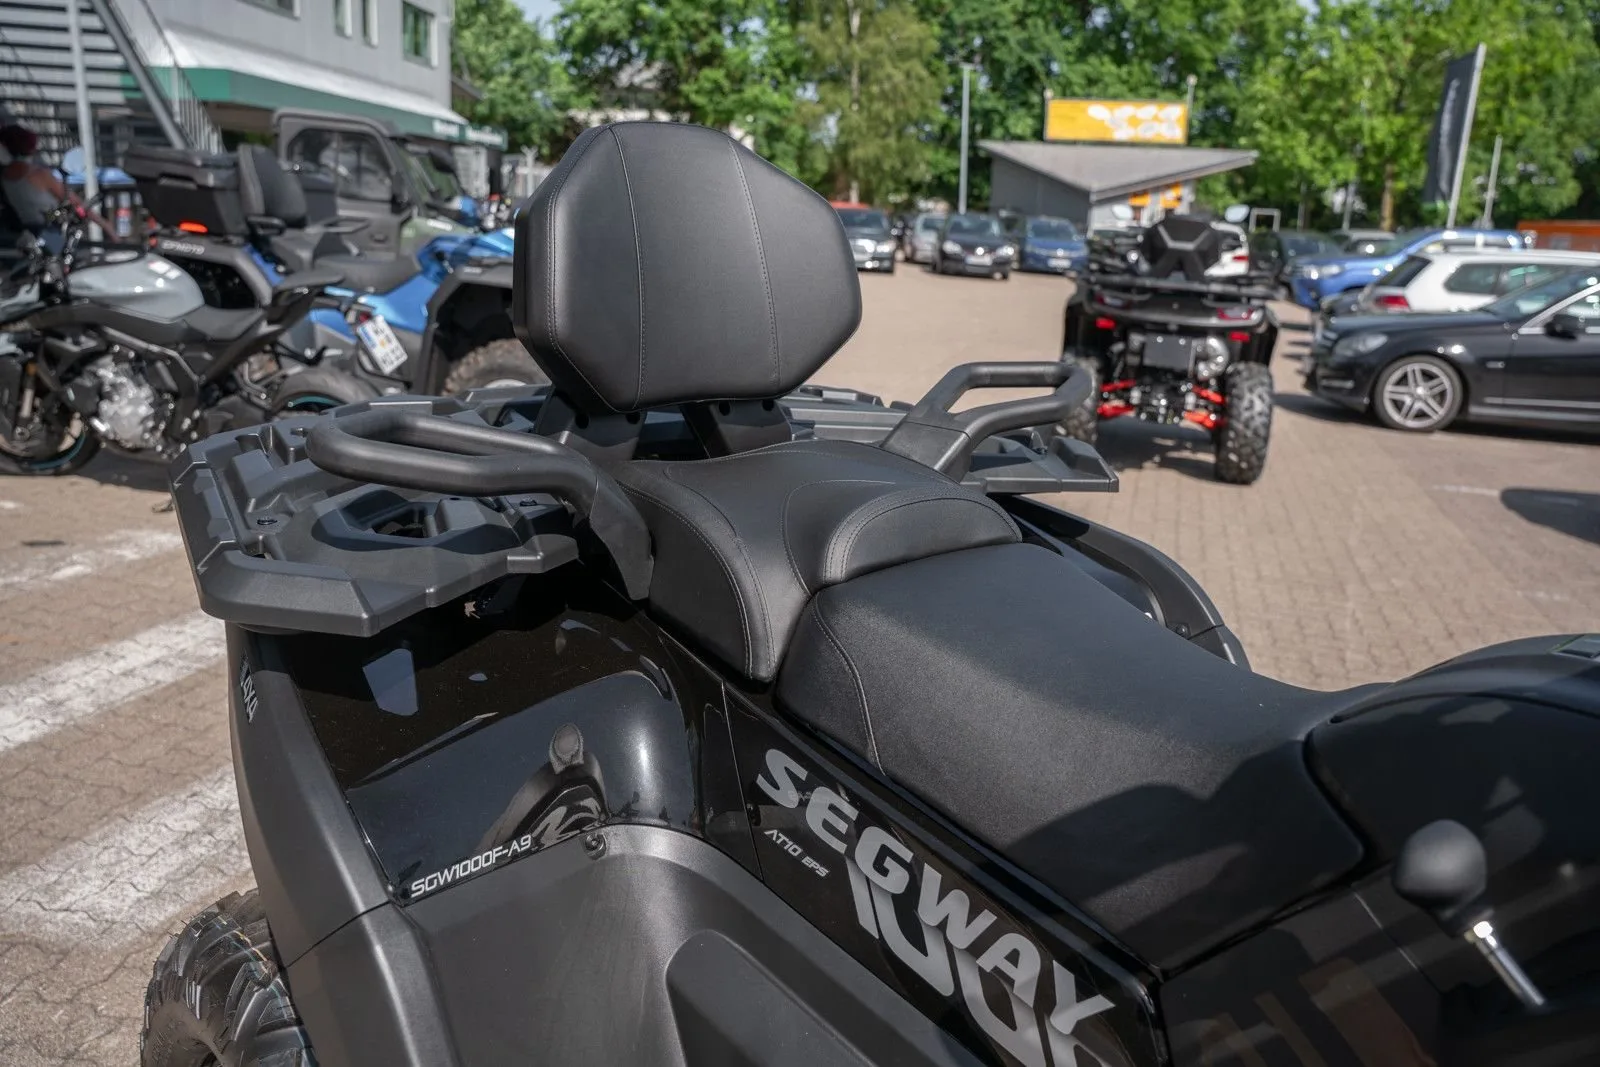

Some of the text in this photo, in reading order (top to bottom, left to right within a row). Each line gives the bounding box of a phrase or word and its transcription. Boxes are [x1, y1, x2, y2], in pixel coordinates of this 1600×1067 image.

[411, 834, 532, 898] SGW1000F-A9
[763, 829, 829, 877] AT10 EPS
[756, 748, 1116, 1036] SEGWAY
